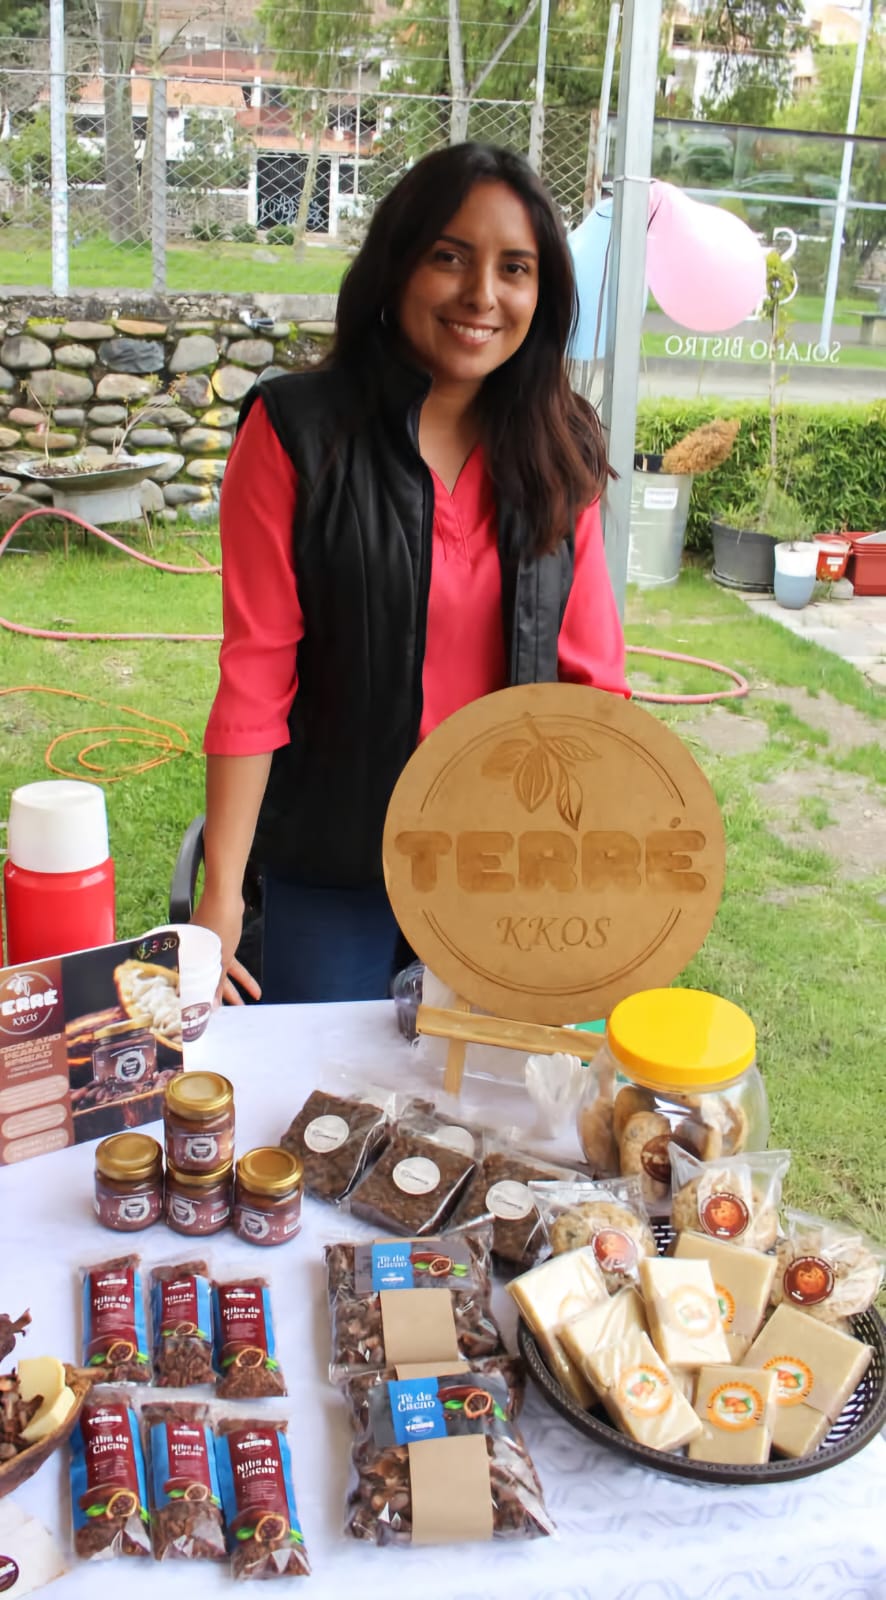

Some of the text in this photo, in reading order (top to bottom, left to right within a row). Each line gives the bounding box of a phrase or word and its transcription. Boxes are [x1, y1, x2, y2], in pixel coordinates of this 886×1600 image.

[394, 816, 707, 894] TERRÉ
[496, 915, 611, 953] KKOS
[0, 987, 59, 1017] ERRÉ
[236, 1457, 279, 1475] Nibs de
[242, 1467, 276, 1479] Cacao
